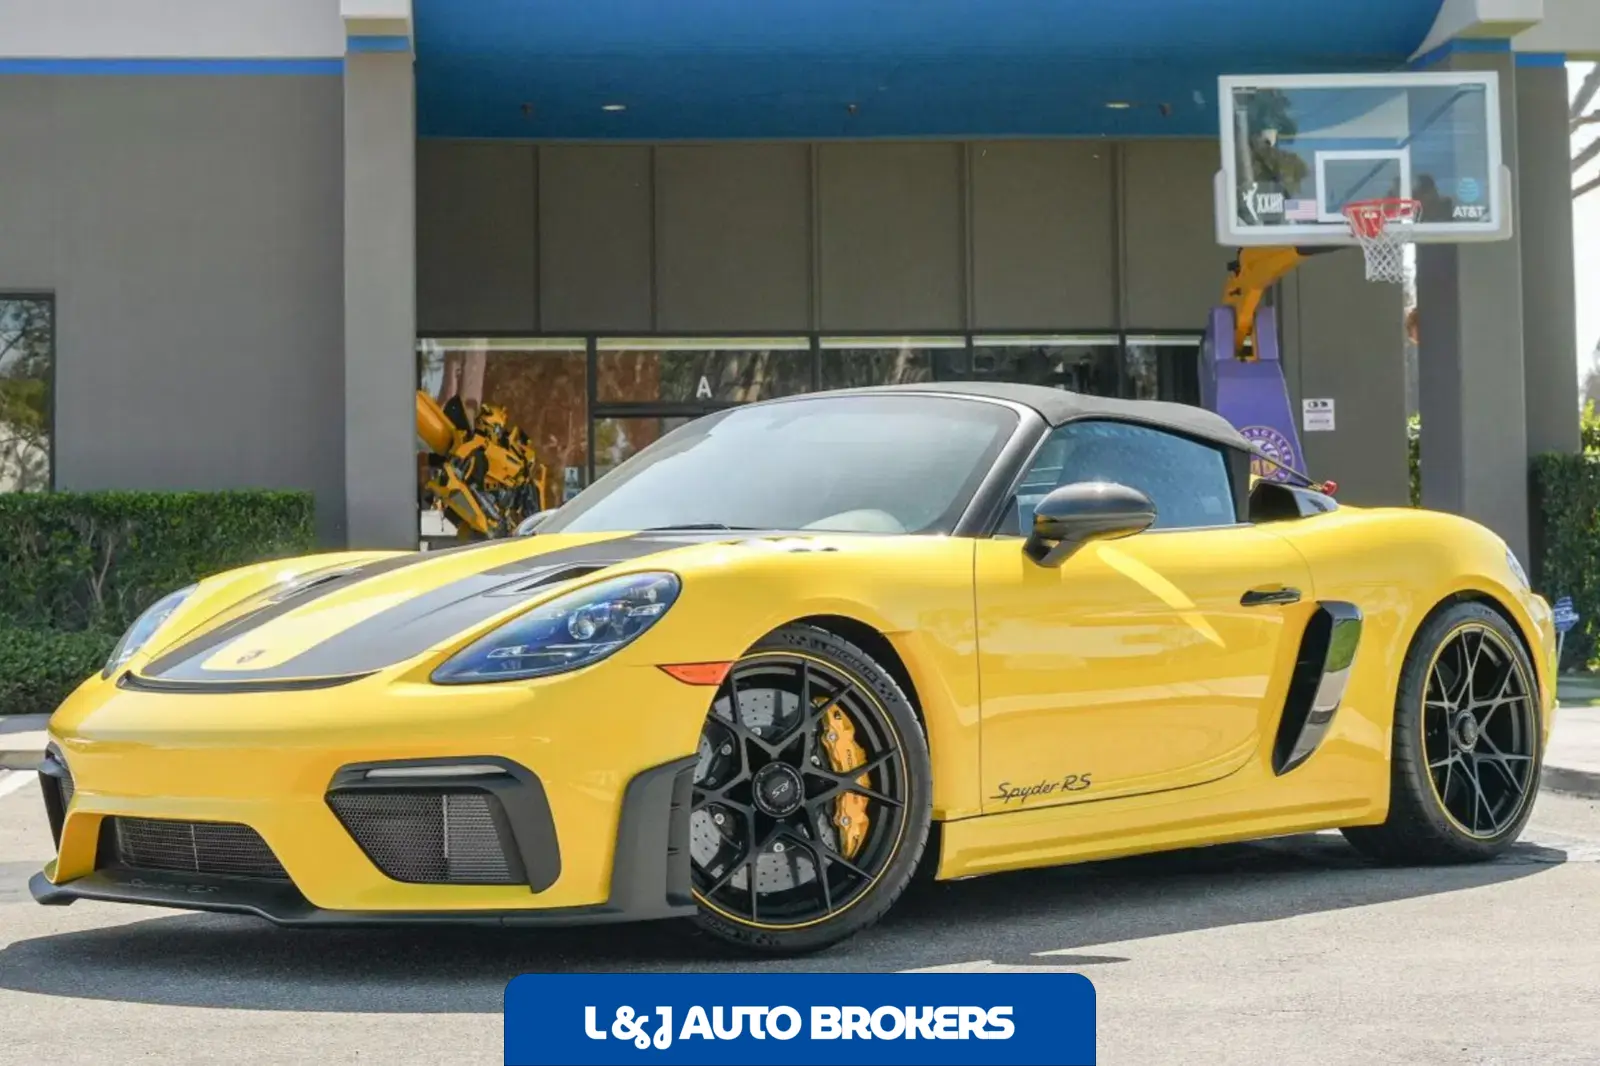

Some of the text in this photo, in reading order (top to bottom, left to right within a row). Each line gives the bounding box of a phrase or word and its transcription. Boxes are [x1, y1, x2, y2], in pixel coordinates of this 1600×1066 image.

[1452, 206, 1485, 218] AT&T
[696, 376, 712, 398] A
[989, 772, 1092, 804] Spyder RS
